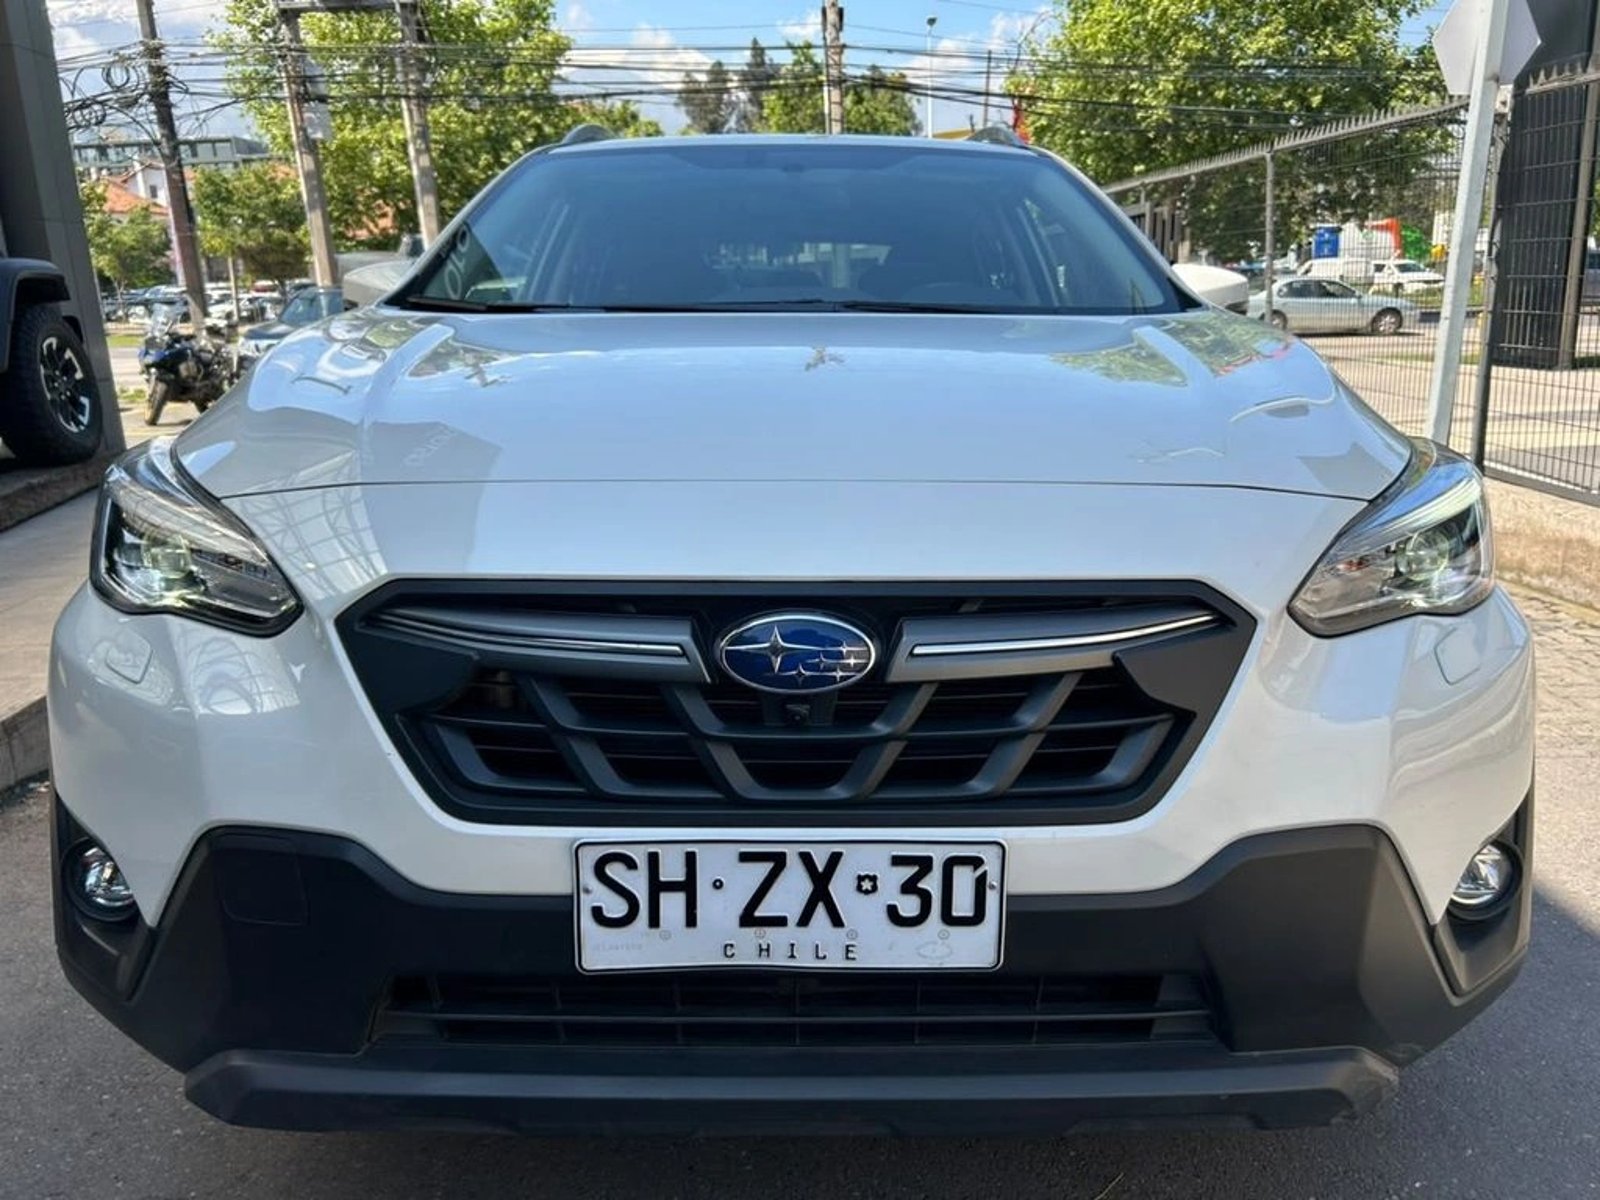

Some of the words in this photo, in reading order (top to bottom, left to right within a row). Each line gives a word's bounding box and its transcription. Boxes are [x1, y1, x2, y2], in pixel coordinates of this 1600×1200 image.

[591, 851, 698, 928] SH
[738, 851, 845, 928] ZX
[886, 854, 988, 928] 30
[723, 942, 858, 961] CHILE
